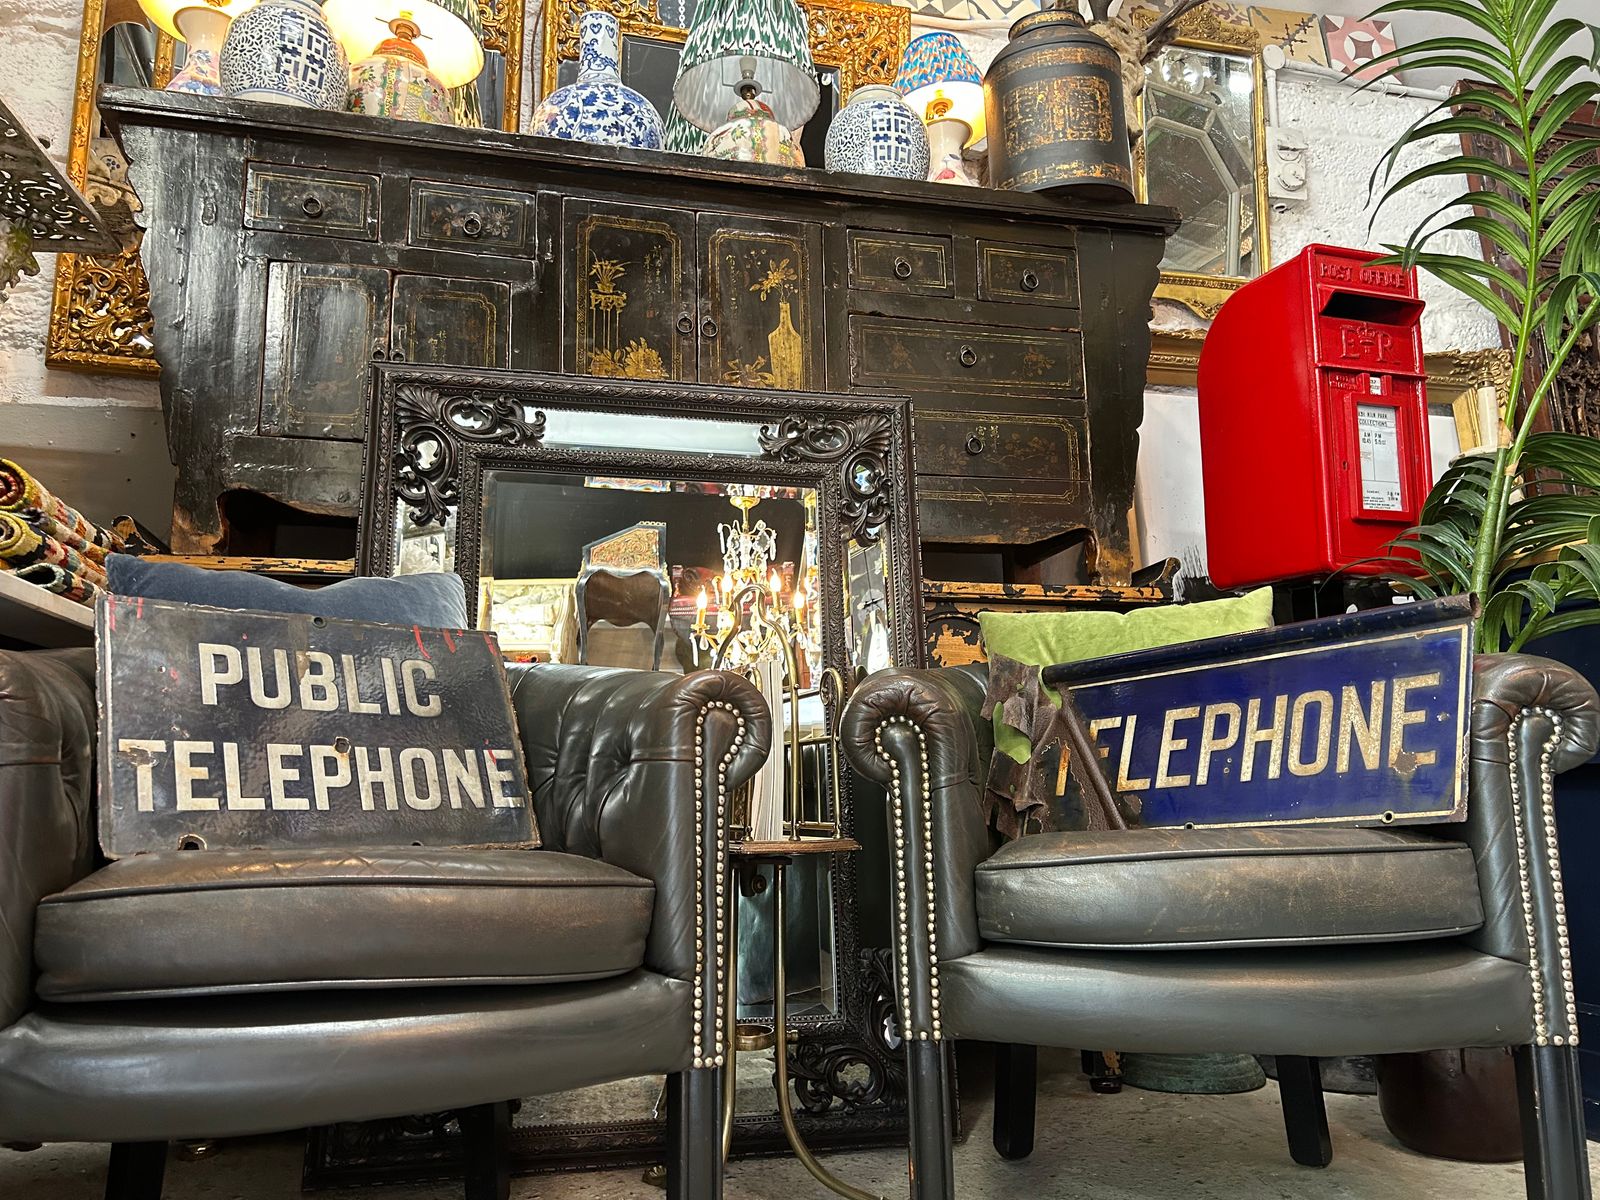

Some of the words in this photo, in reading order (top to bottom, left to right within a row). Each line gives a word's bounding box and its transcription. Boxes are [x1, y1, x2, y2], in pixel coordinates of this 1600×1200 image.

[1320, 262, 1352, 281] POST
[1360, 269, 1406, 289] OFFICE
[198, 642, 443, 718] PUBLIC
[118, 738, 526, 812] TELEPHONE
